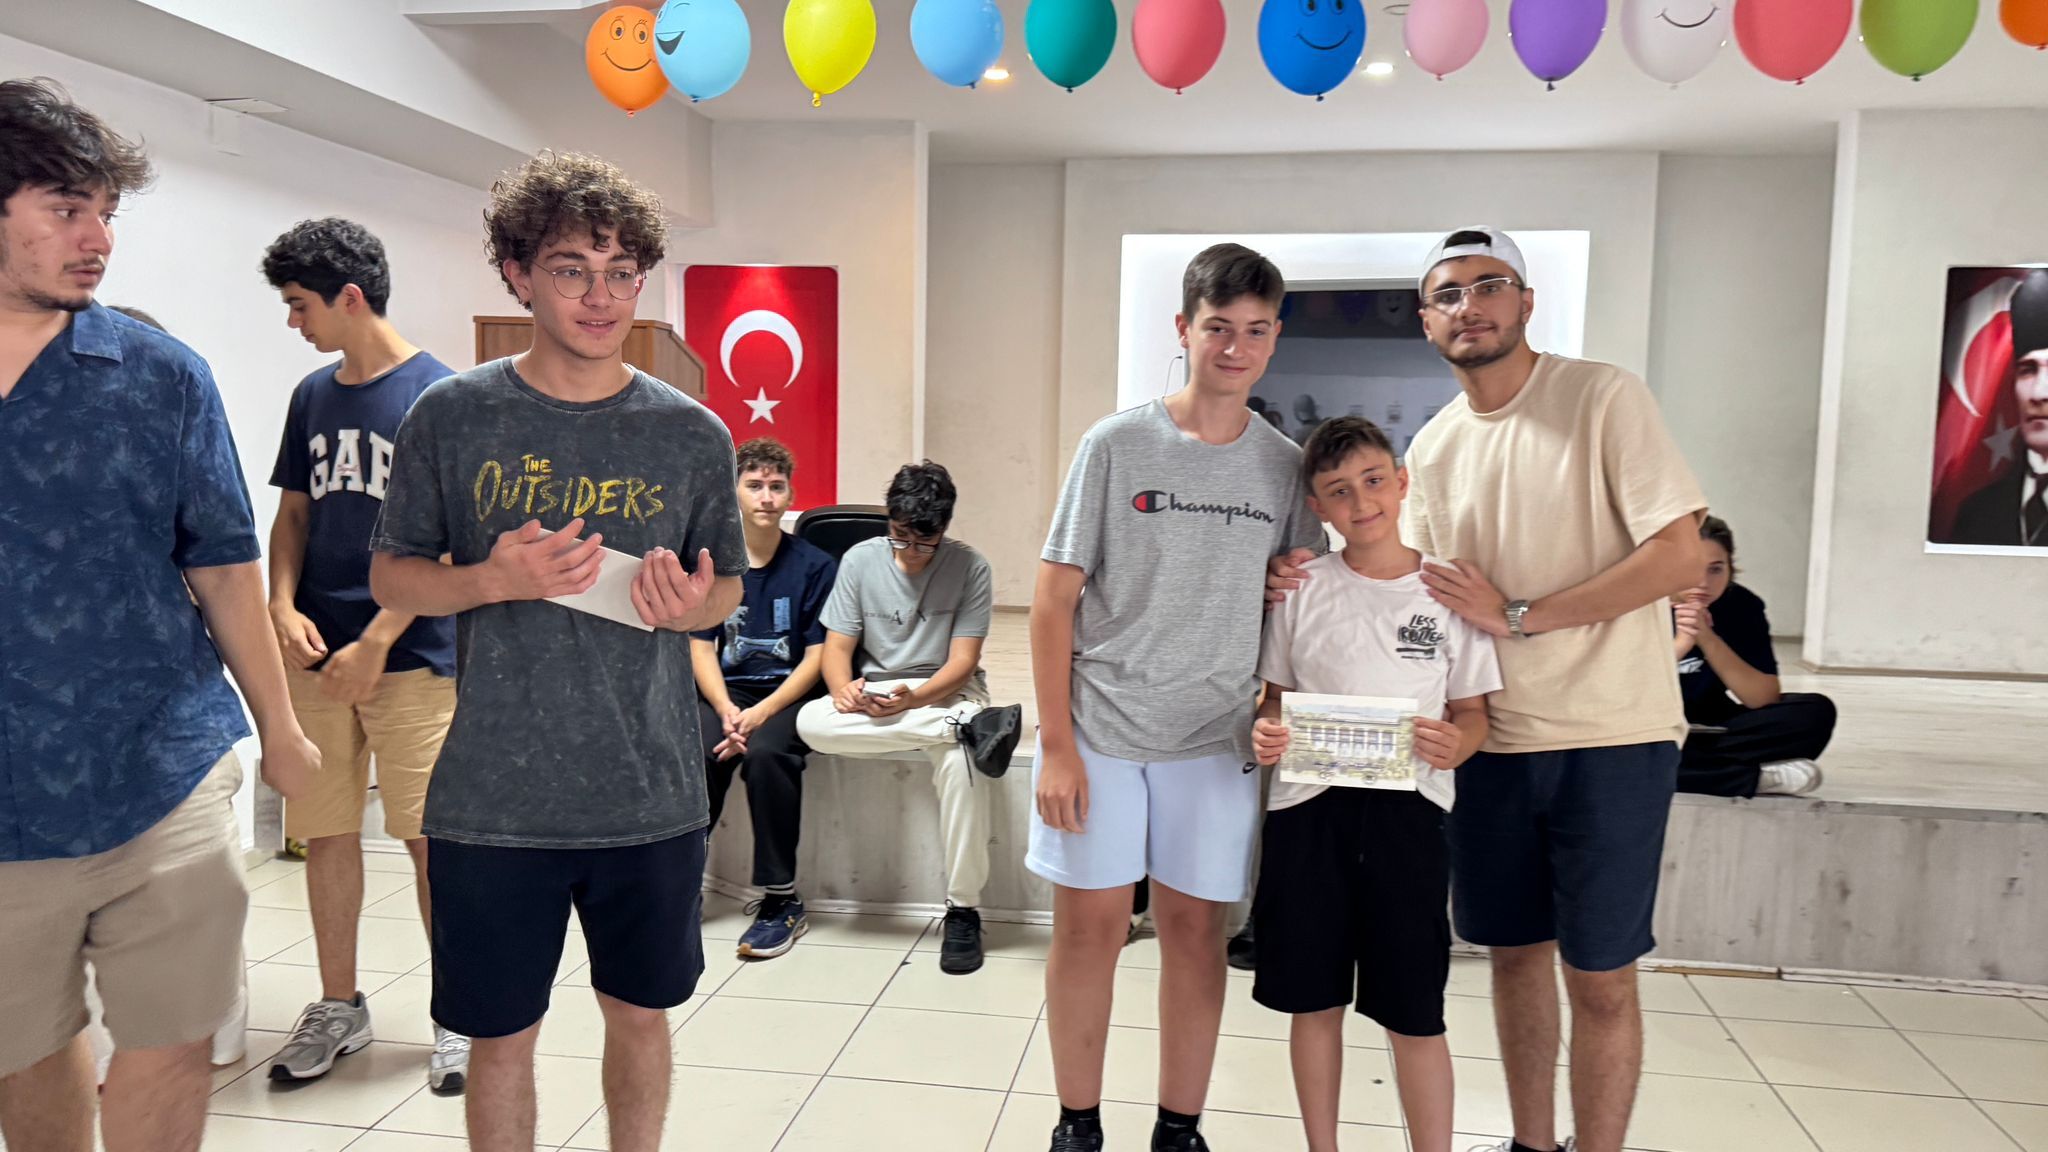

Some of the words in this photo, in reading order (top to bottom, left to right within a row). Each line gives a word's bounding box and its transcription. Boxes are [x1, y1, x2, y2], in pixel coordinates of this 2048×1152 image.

[521, 453, 552, 473] THE
[474, 460, 665, 526] OUTSIDERS
[1132, 490, 1275, 525] Champion
[1408, 614, 1438, 631] LESS
